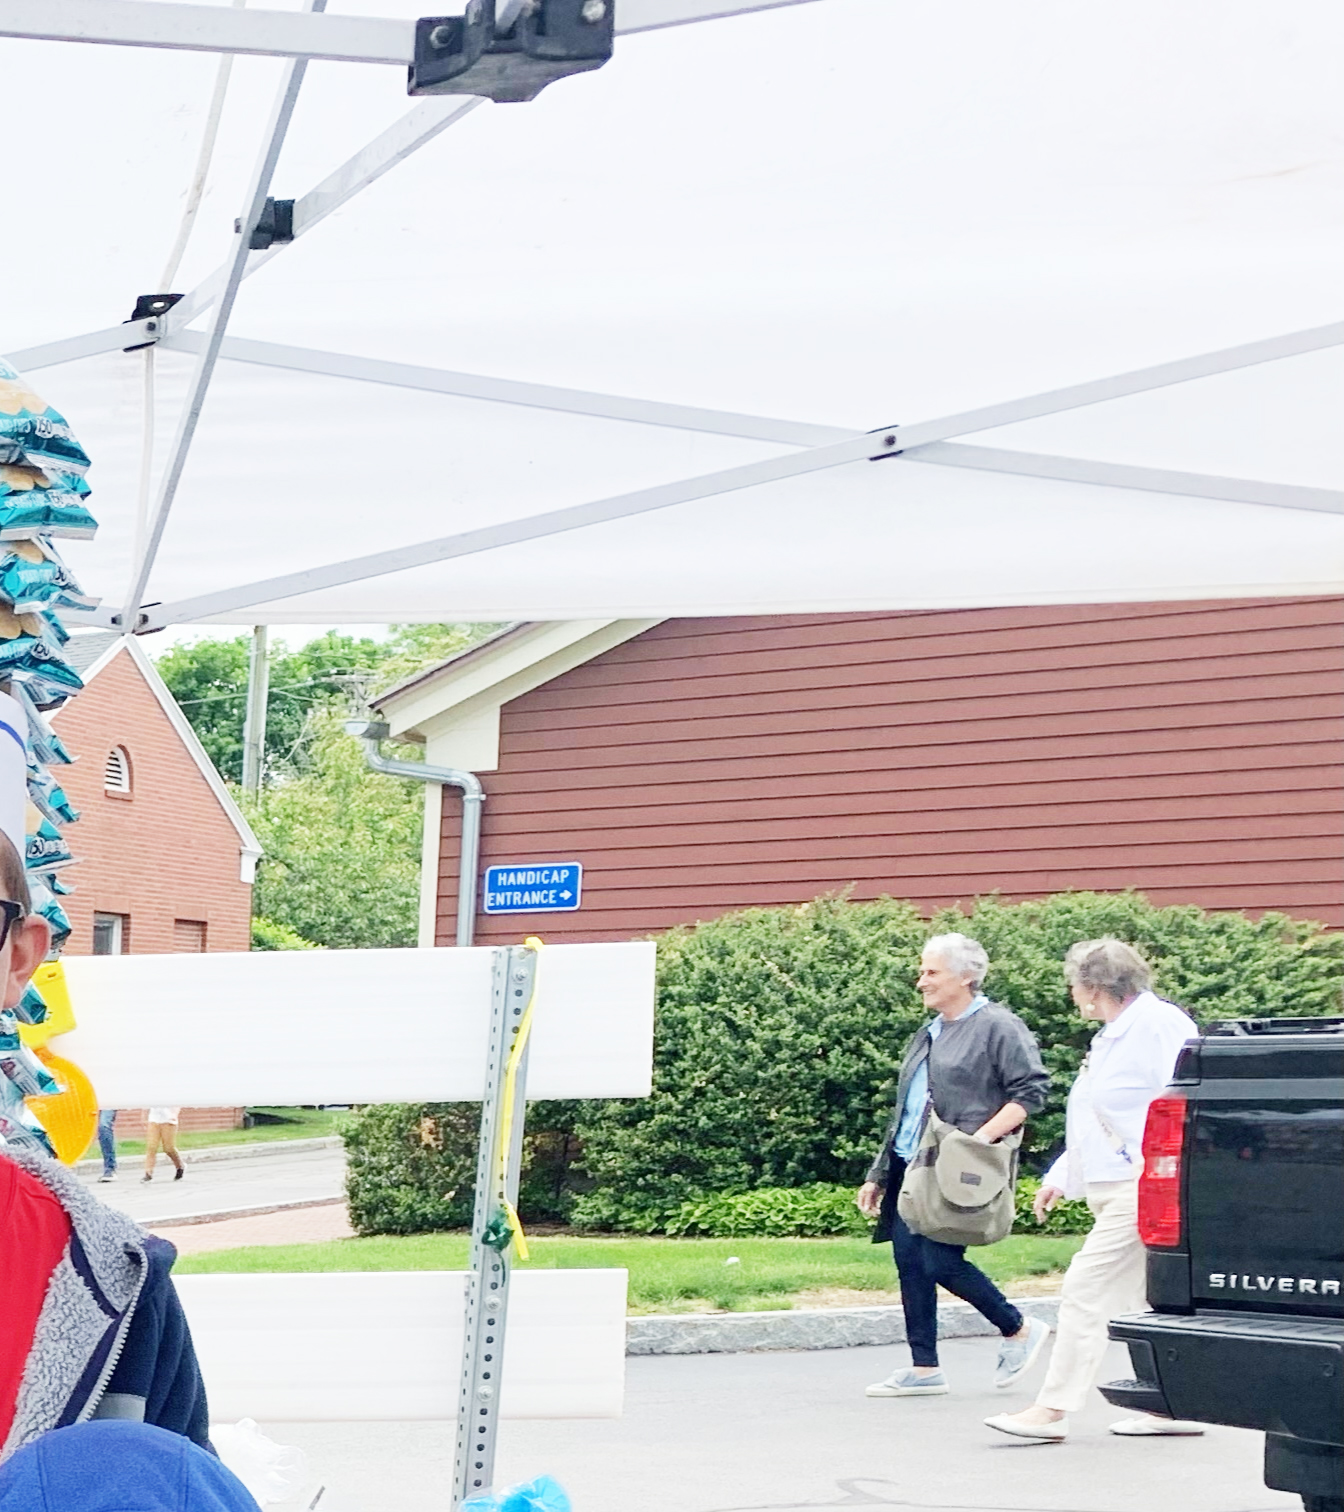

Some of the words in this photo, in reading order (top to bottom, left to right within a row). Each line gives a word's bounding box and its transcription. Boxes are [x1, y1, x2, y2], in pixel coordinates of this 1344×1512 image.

[498, 869, 569, 886] HANDICAP
[487, 889, 557, 907] ENTRANCE
[1209, 1273, 1341, 1295] SILVERA
